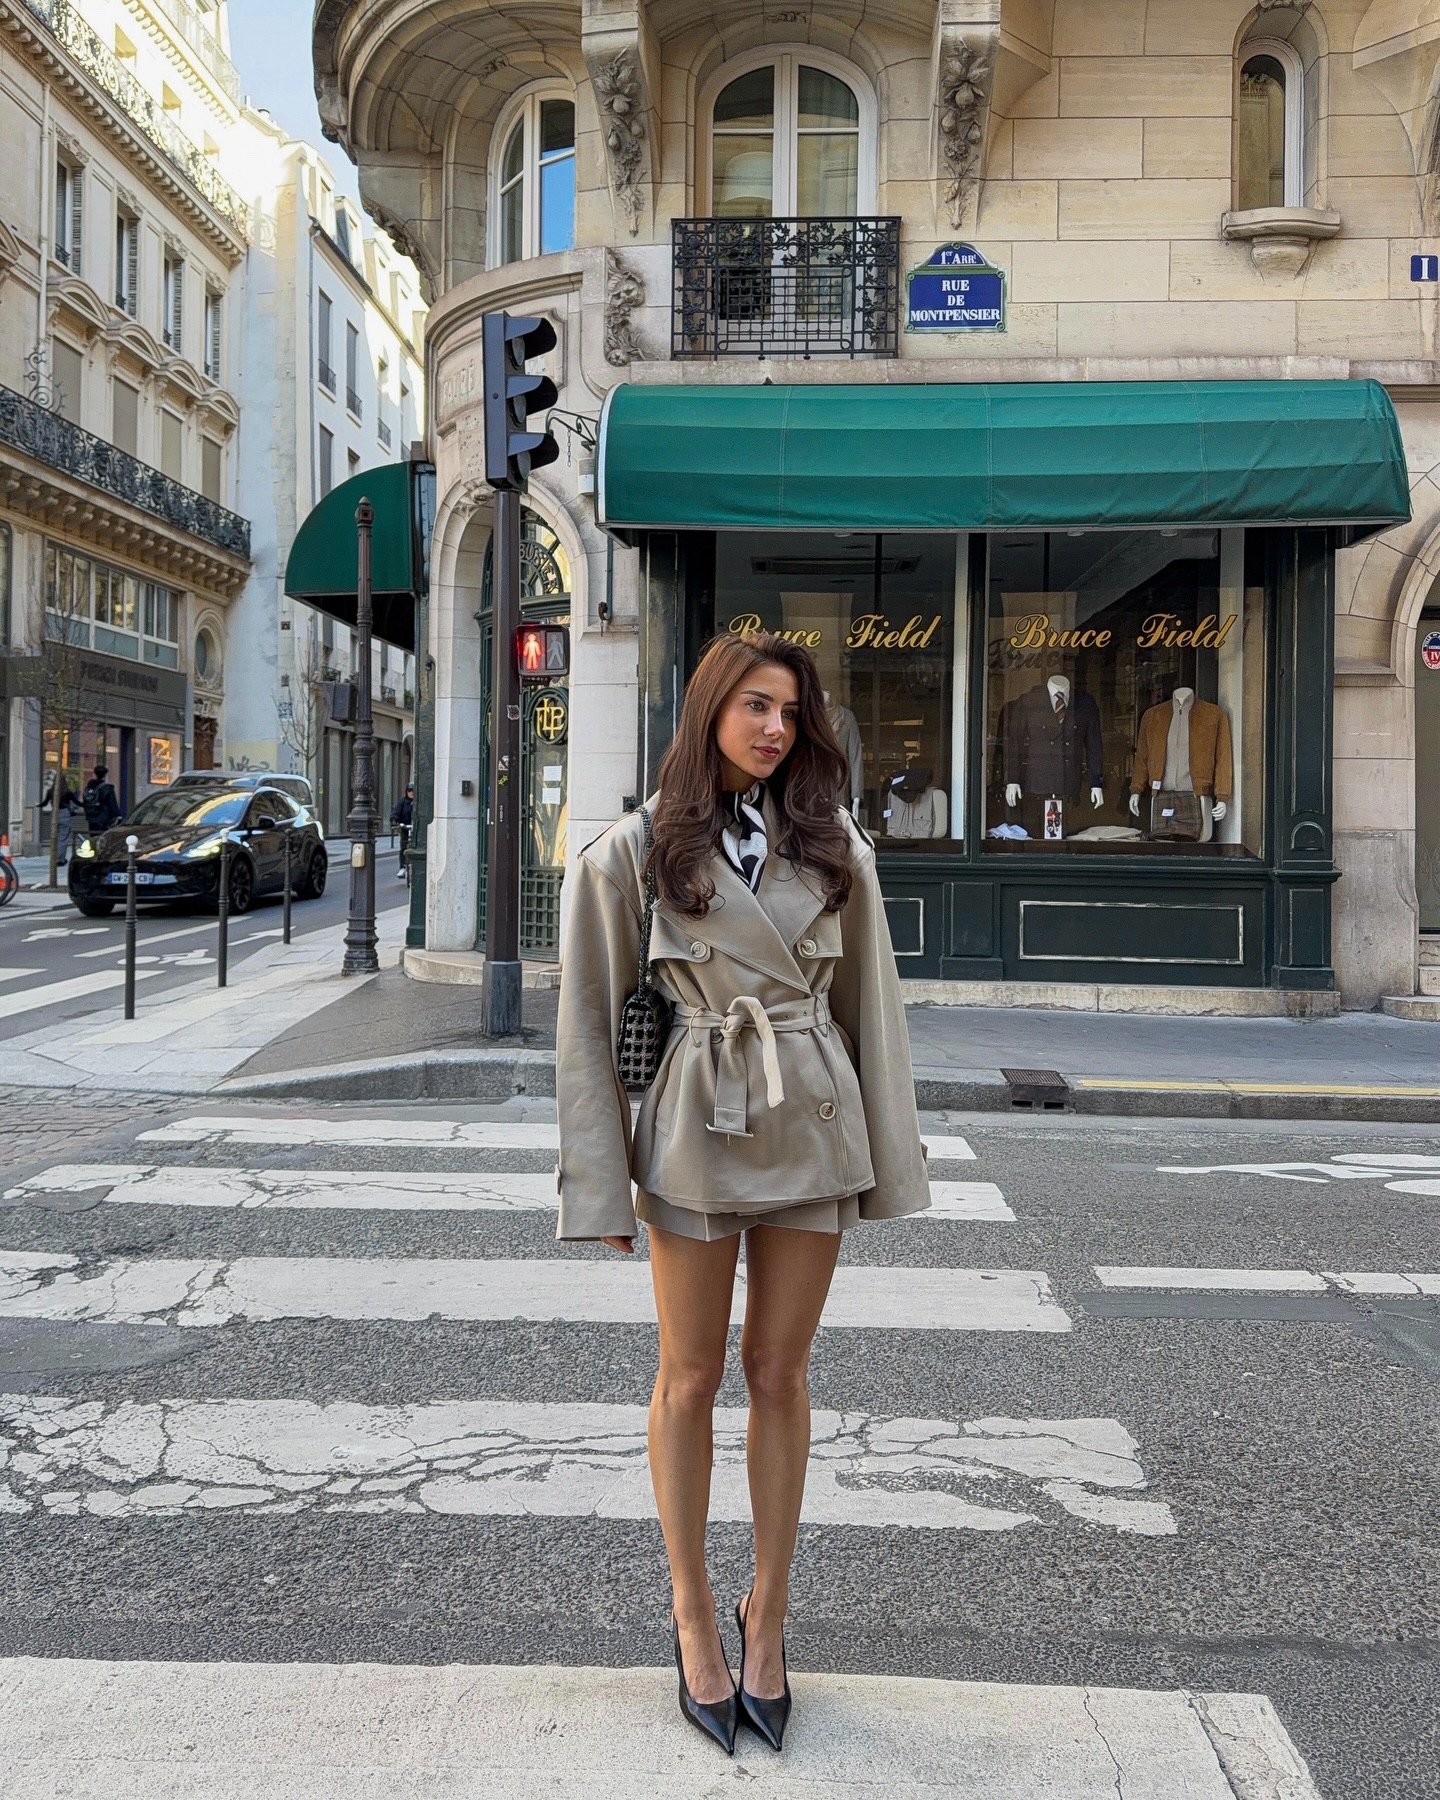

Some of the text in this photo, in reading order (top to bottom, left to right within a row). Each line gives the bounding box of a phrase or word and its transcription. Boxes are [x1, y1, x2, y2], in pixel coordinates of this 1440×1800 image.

[942, 280, 970, 291] RUE
[947, 295, 965, 306] DE
[910, 309, 1001, 321] MONTPENSIER
[728, 613, 942, 648] Buce Field
[1010, 613, 1238, 648] Bruce Field
